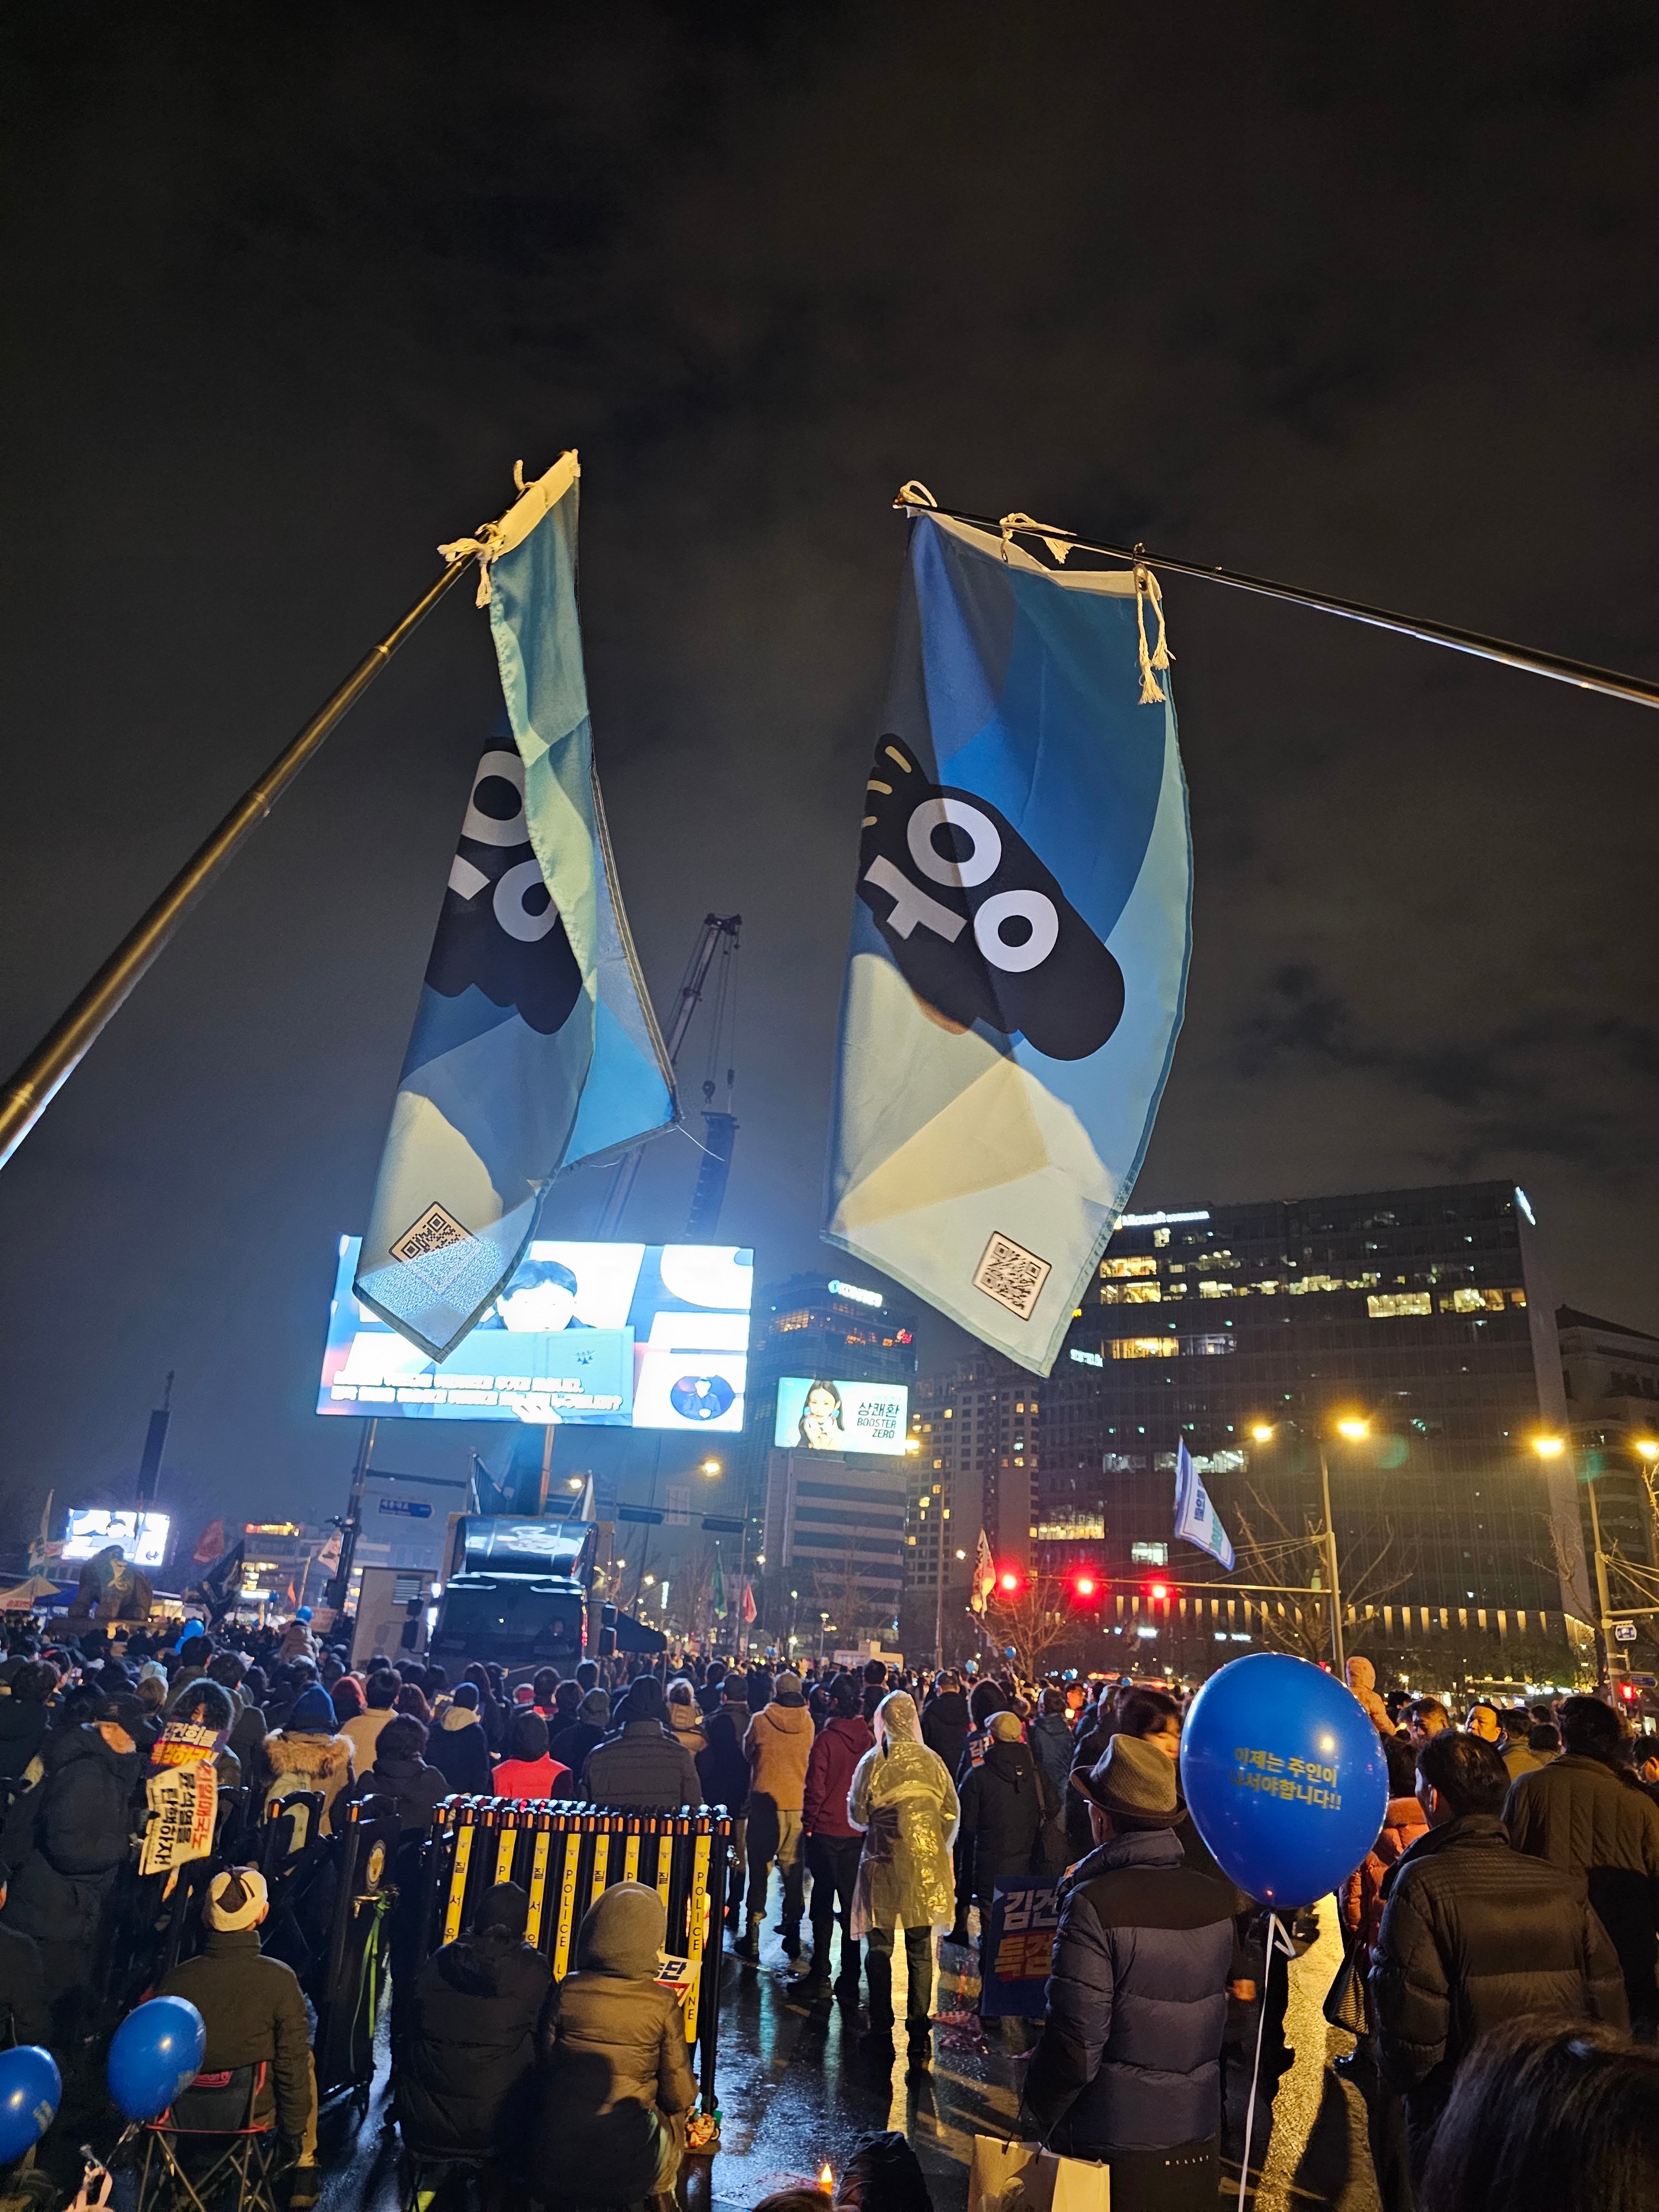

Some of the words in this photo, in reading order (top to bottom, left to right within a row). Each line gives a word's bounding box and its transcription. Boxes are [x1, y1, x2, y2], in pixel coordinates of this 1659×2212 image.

[857, 1417, 896, 1428] BOOSTER
[858, 1402, 900, 1418] 상쾌환
[872, 1428, 895, 1438] ZERO
[162, 1722, 219, 1748] 김건희를
[1234, 1747, 1285, 1774] 이제는
[1288, 1756, 1338, 1788] 주인이
[178, 1772, 196, 1844] 윤석열을
[1229, 1768, 1342, 1811] 나서야합니다!!
[154, 1788, 179, 1865] 탄핵하자!
[560, 1869, 573, 1947] POLICE
[692, 1872, 704, 1950] POLICE
